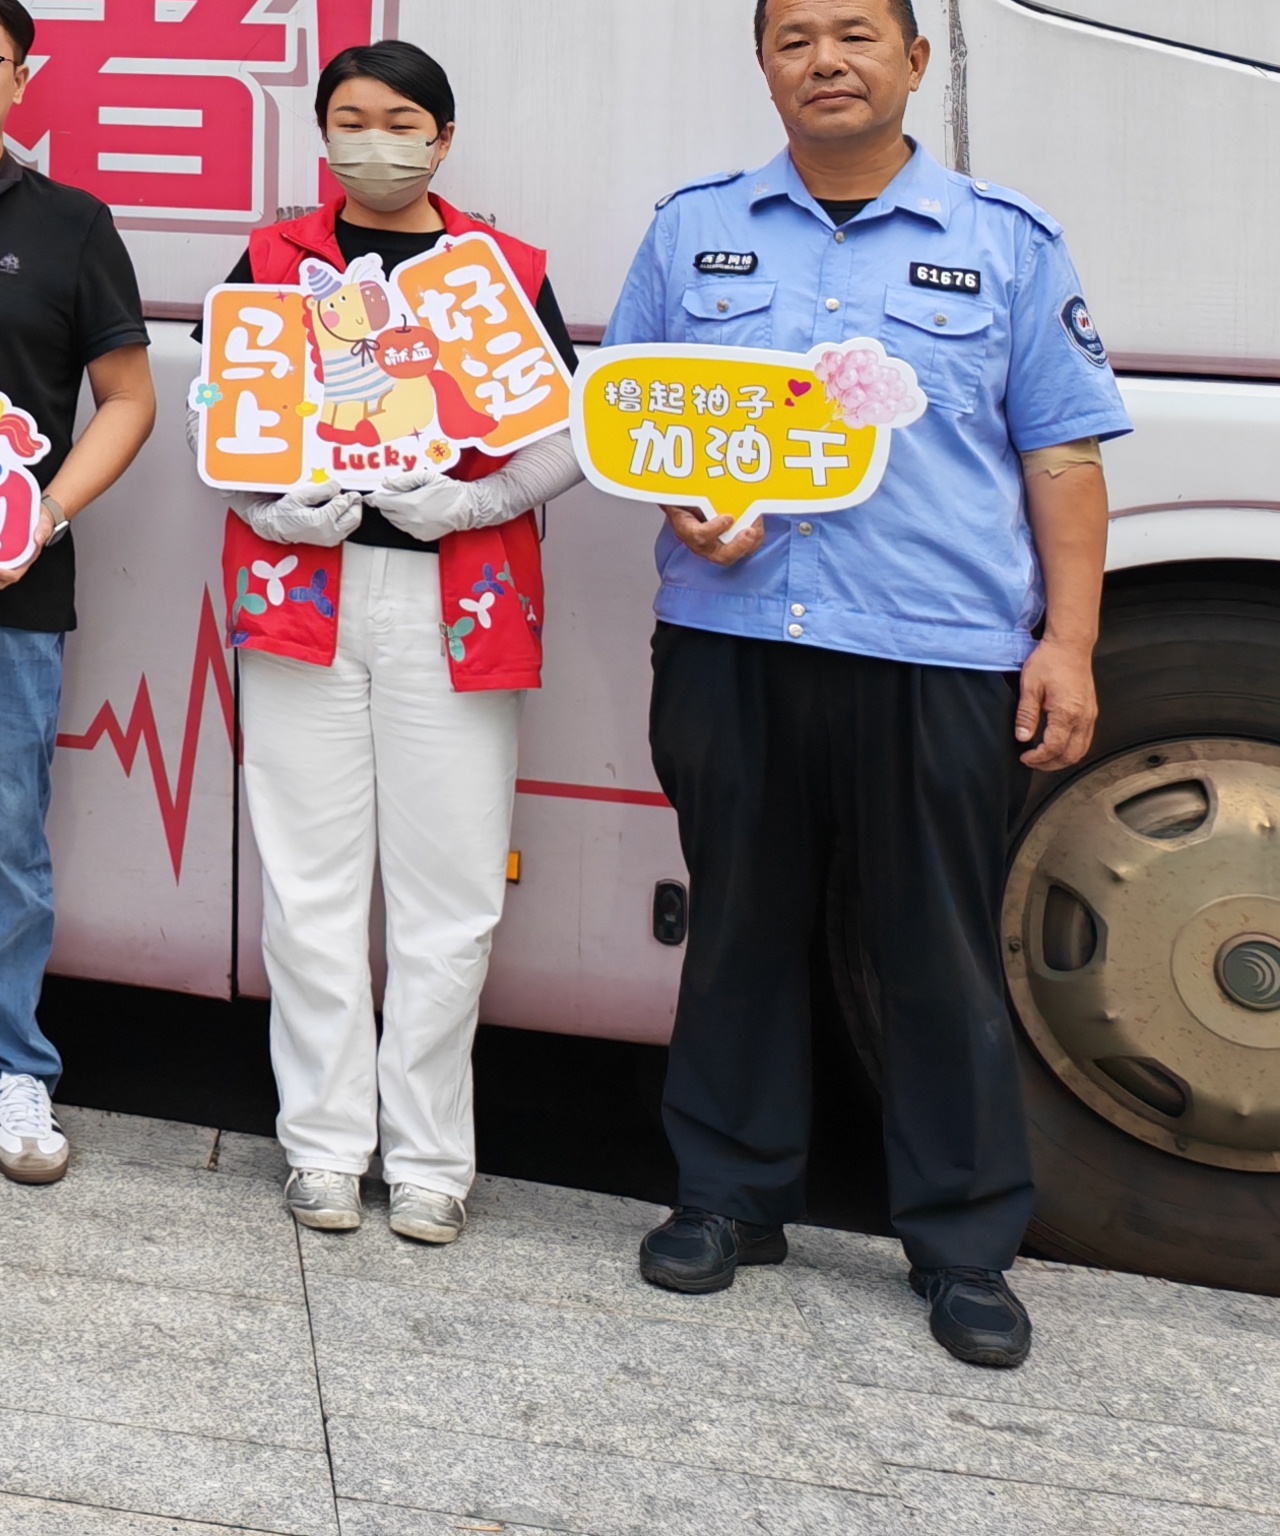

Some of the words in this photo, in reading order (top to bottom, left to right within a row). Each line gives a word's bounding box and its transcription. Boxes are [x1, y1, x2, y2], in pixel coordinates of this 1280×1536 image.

[915, 265, 977, 289] 61676
[384, 341, 433, 366] 献血
[417, 264, 555, 422] 好运
[215, 306, 290, 454] 马上
[604, 378, 774, 418] 撸起袖子
[332, 444, 417, 472] Lucky
[627, 419, 850, 487] 加油干
